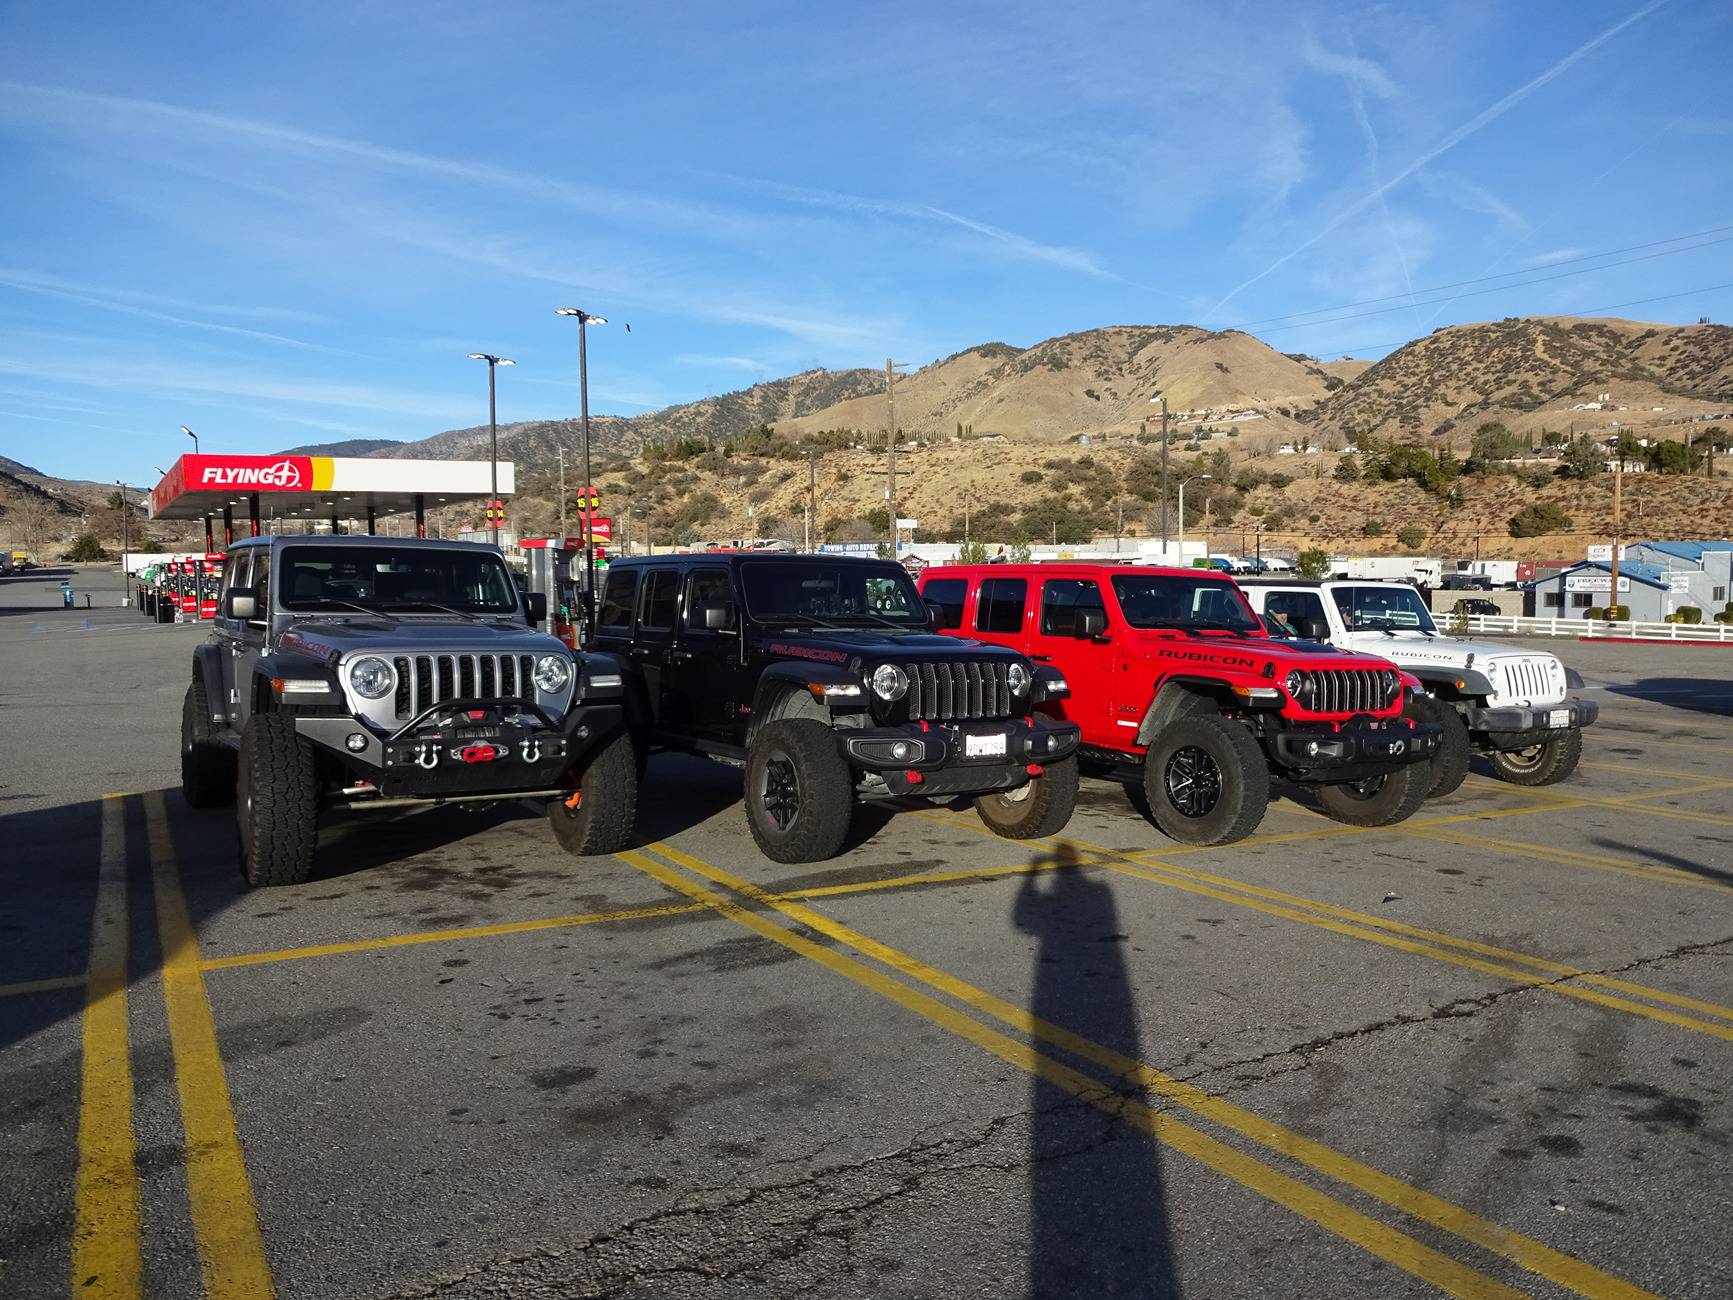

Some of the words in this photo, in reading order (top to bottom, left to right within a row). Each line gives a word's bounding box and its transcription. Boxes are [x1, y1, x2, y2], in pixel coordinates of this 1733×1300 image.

[577, 498, 585, 508] 15
[591, 497, 599, 508] 16
[497, 509, 504, 518] 14
[824, 544, 843, 552] TOWING
[770, 644, 848, 663] RUBICON
[1159, 649, 1255, 667] RUBICON
[1391, 651, 1453, 661] RUBICON
